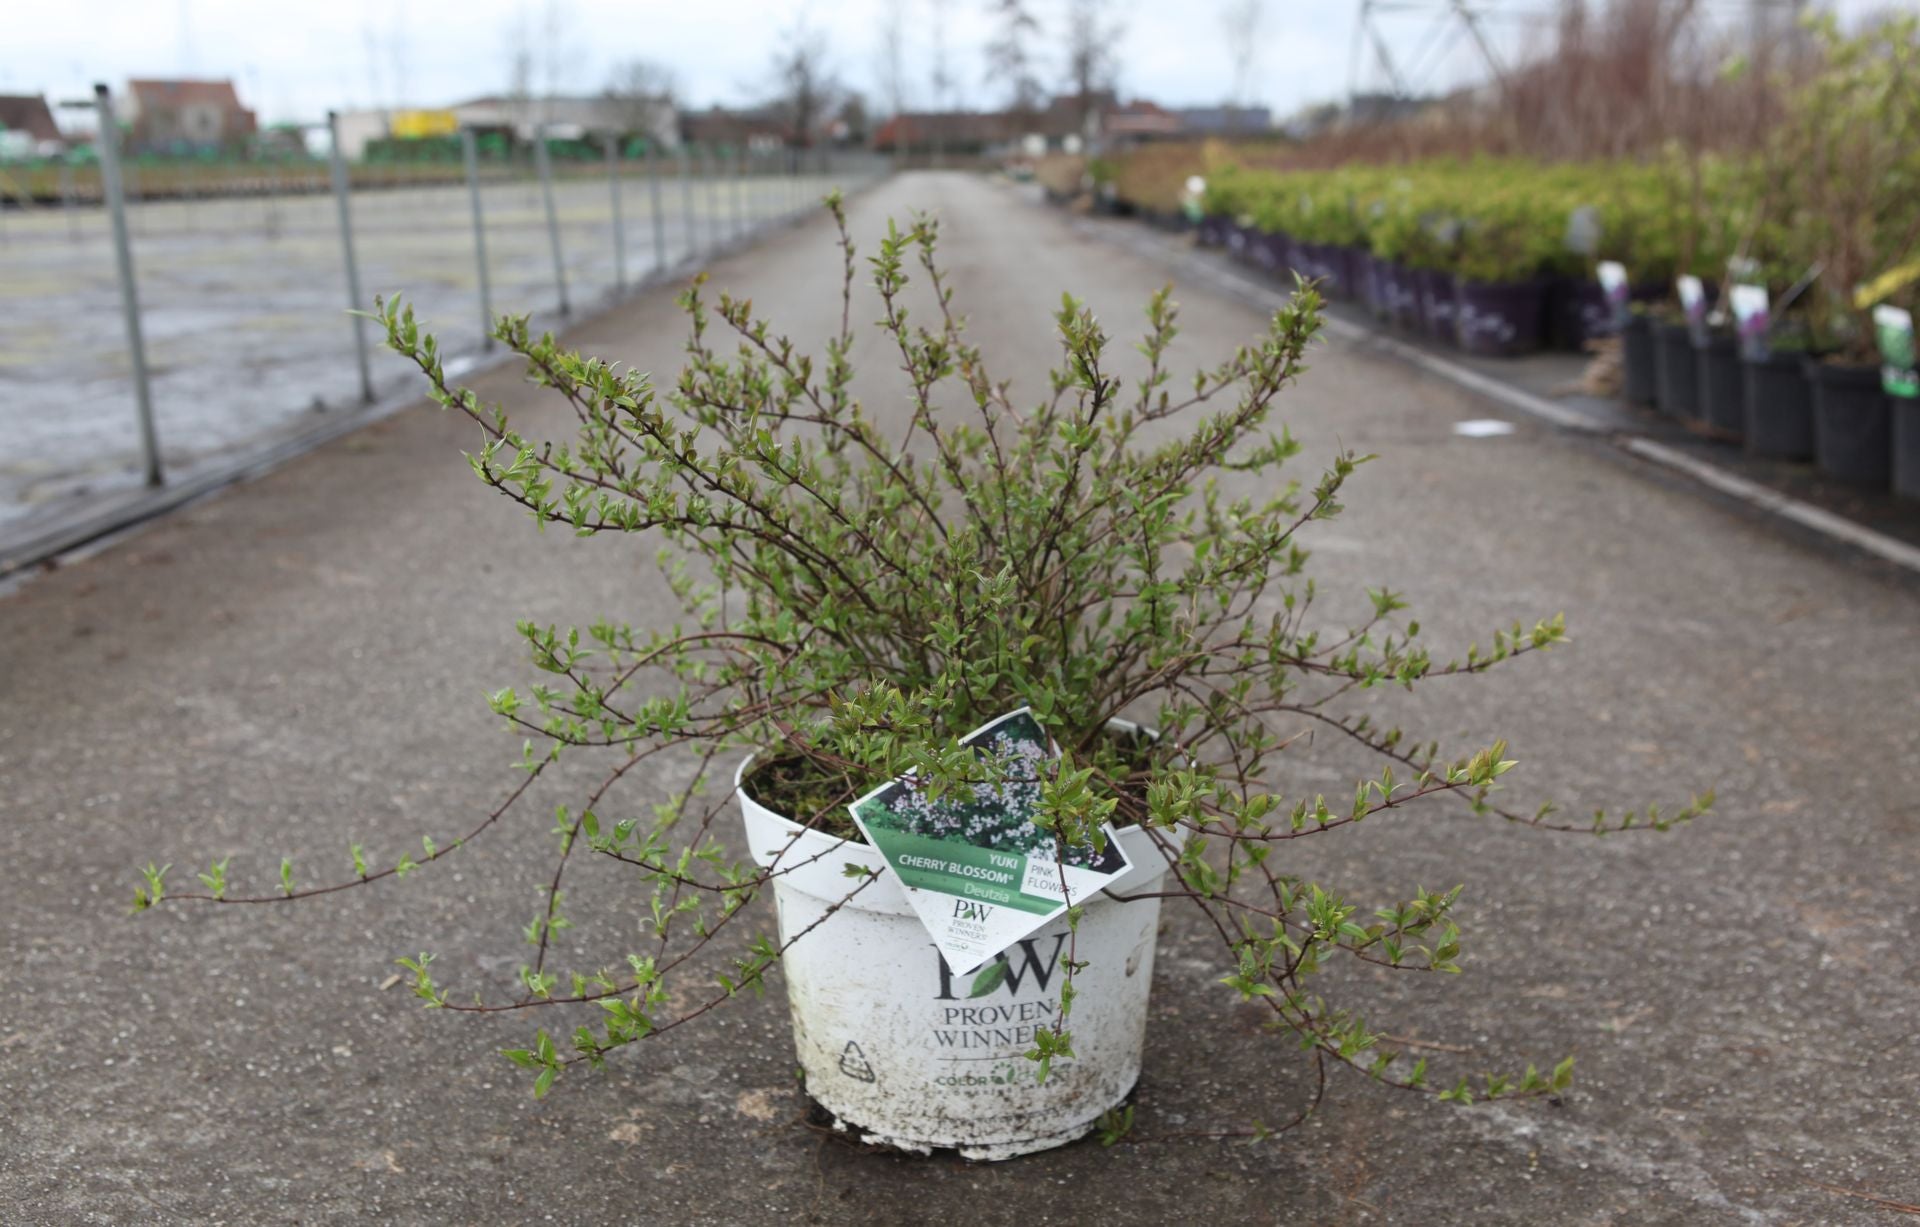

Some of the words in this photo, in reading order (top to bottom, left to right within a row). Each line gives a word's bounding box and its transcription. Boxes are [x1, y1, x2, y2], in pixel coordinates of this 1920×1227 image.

[899, 854, 947, 871] CHERRY
[989, 854, 1018, 869] YUKI
[1031, 865, 1054, 878] PINK
[964, 883, 1009, 903] Deutzia
[945, 998, 1054, 1026] PROVEN
